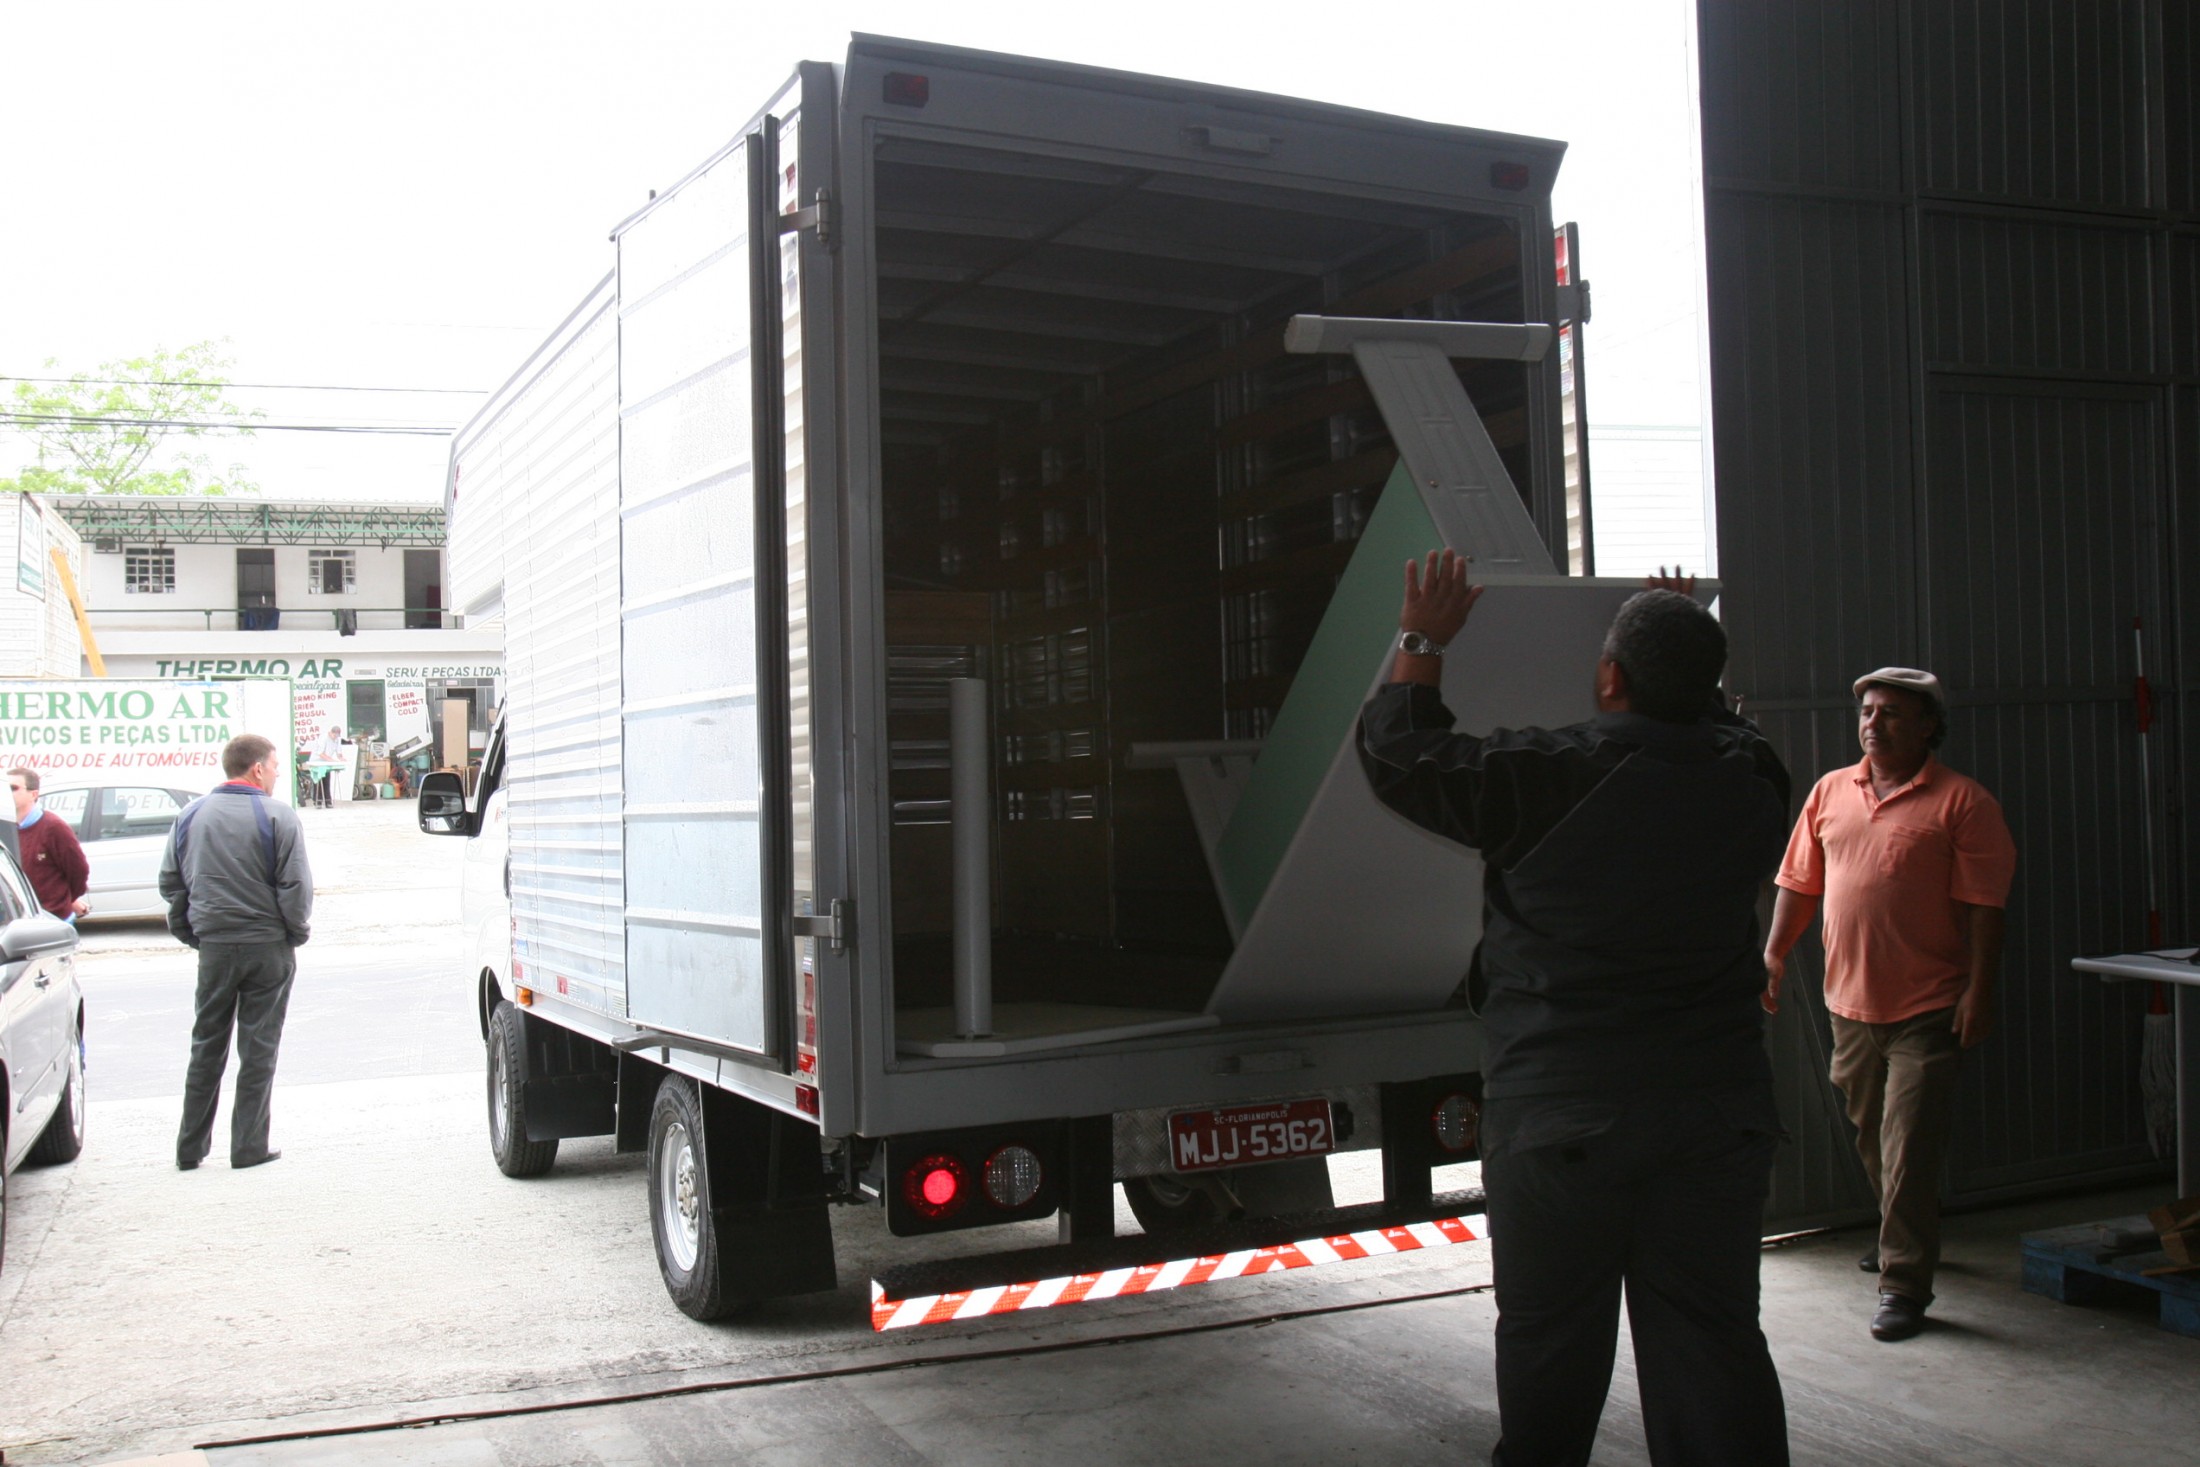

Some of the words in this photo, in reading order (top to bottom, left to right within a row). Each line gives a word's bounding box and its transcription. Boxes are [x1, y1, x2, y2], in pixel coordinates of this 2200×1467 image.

[156, 659, 290, 678] THERMO
[298, 659, 343, 678] AR
[422, 667, 429, 677] E
[318, 692, 337, 700] KING
[393, 698, 424, 708] COMPACT
[168, 690, 231, 719] AR
[398, 708, 418, 716] COLD
[0, 725, 72, 748] VIÇOS
[80, 726, 91, 744] E
[100, 725, 170, 747] PEÇAS
[179, 724, 231, 744] LTDA
[82, 753, 104, 768] DE
[110, 747, 218, 768] AUTOMÓVEIS
